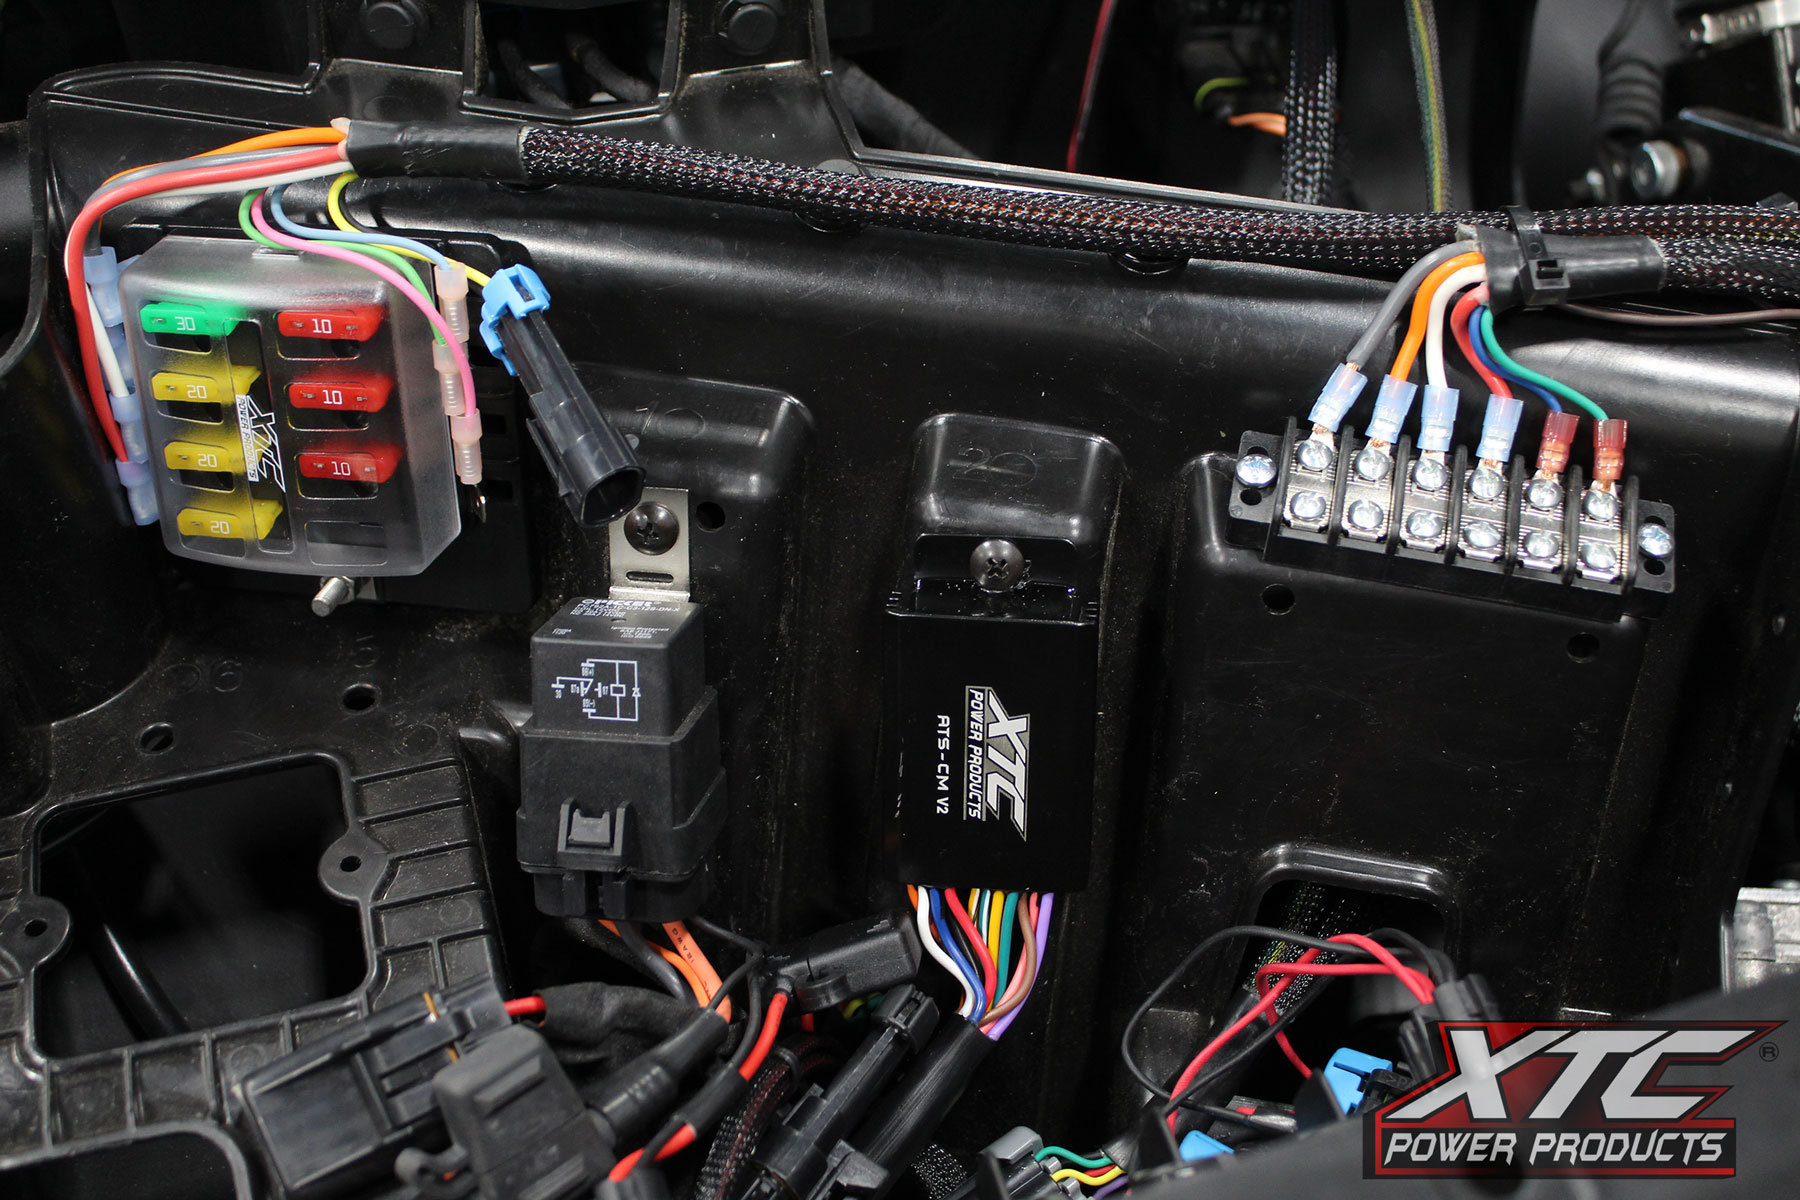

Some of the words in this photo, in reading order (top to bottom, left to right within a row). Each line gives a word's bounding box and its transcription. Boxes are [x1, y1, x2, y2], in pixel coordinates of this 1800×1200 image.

[176, 316, 195, 331] 30
[312, 319, 332, 334] 10
[187, 385, 207, 399] 20
[323, 390, 343, 405] 10
[238, 398, 249, 431] POWER
[197, 453, 217, 468] 20
[332, 462, 351, 476] 10
[210, 520, 230, 535] 20
[969, 688, 984, 740] POWER
[936, 714, 950, 791] ATS-CM
[987, 690, 1027, 832] XTC
[968, 744, 983, 820] PRODUCTS
[936, 797, 949, 815] V2
